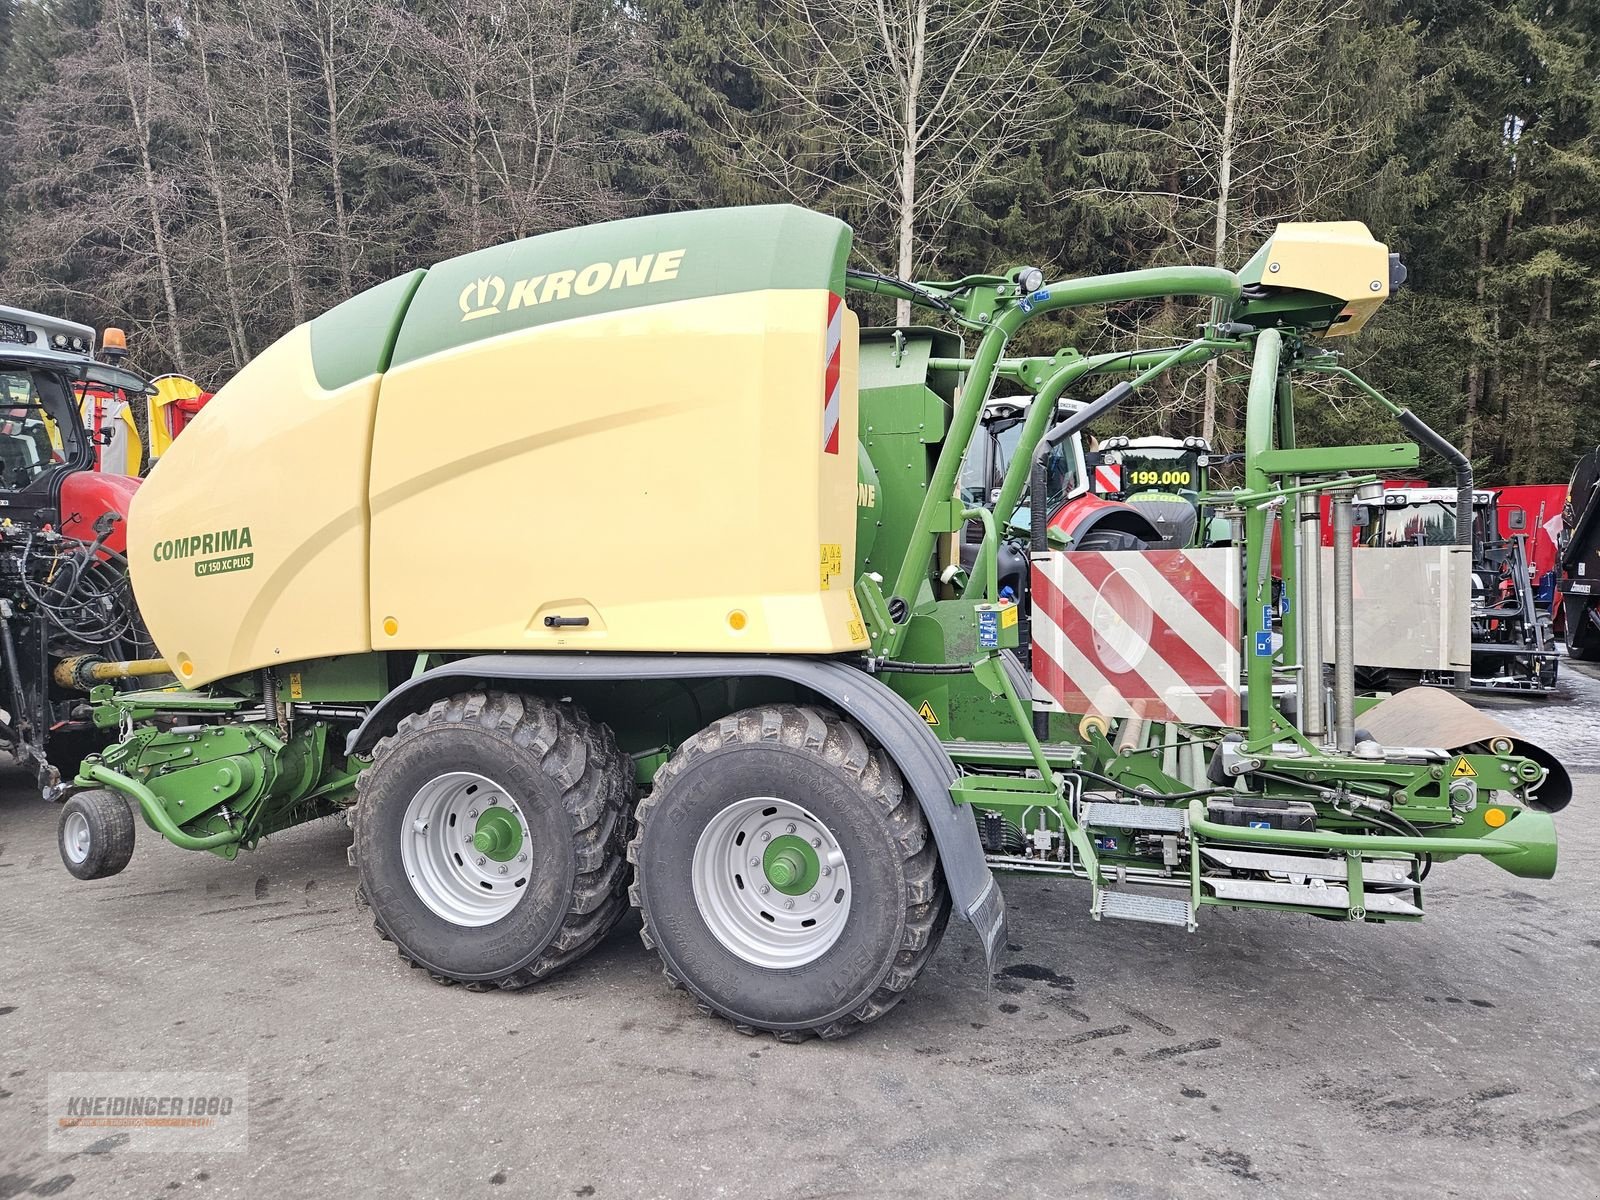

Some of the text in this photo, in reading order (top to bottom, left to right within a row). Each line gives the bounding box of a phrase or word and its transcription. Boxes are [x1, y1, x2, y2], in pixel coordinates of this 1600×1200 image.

[507, 248, 687, 311] KRONE
[1130, 471, 1190, 485] 199.000
[153, 527, 253, 563] COMPRIMA
[197, 556, 251, 574] CV 150 XC PLUS
